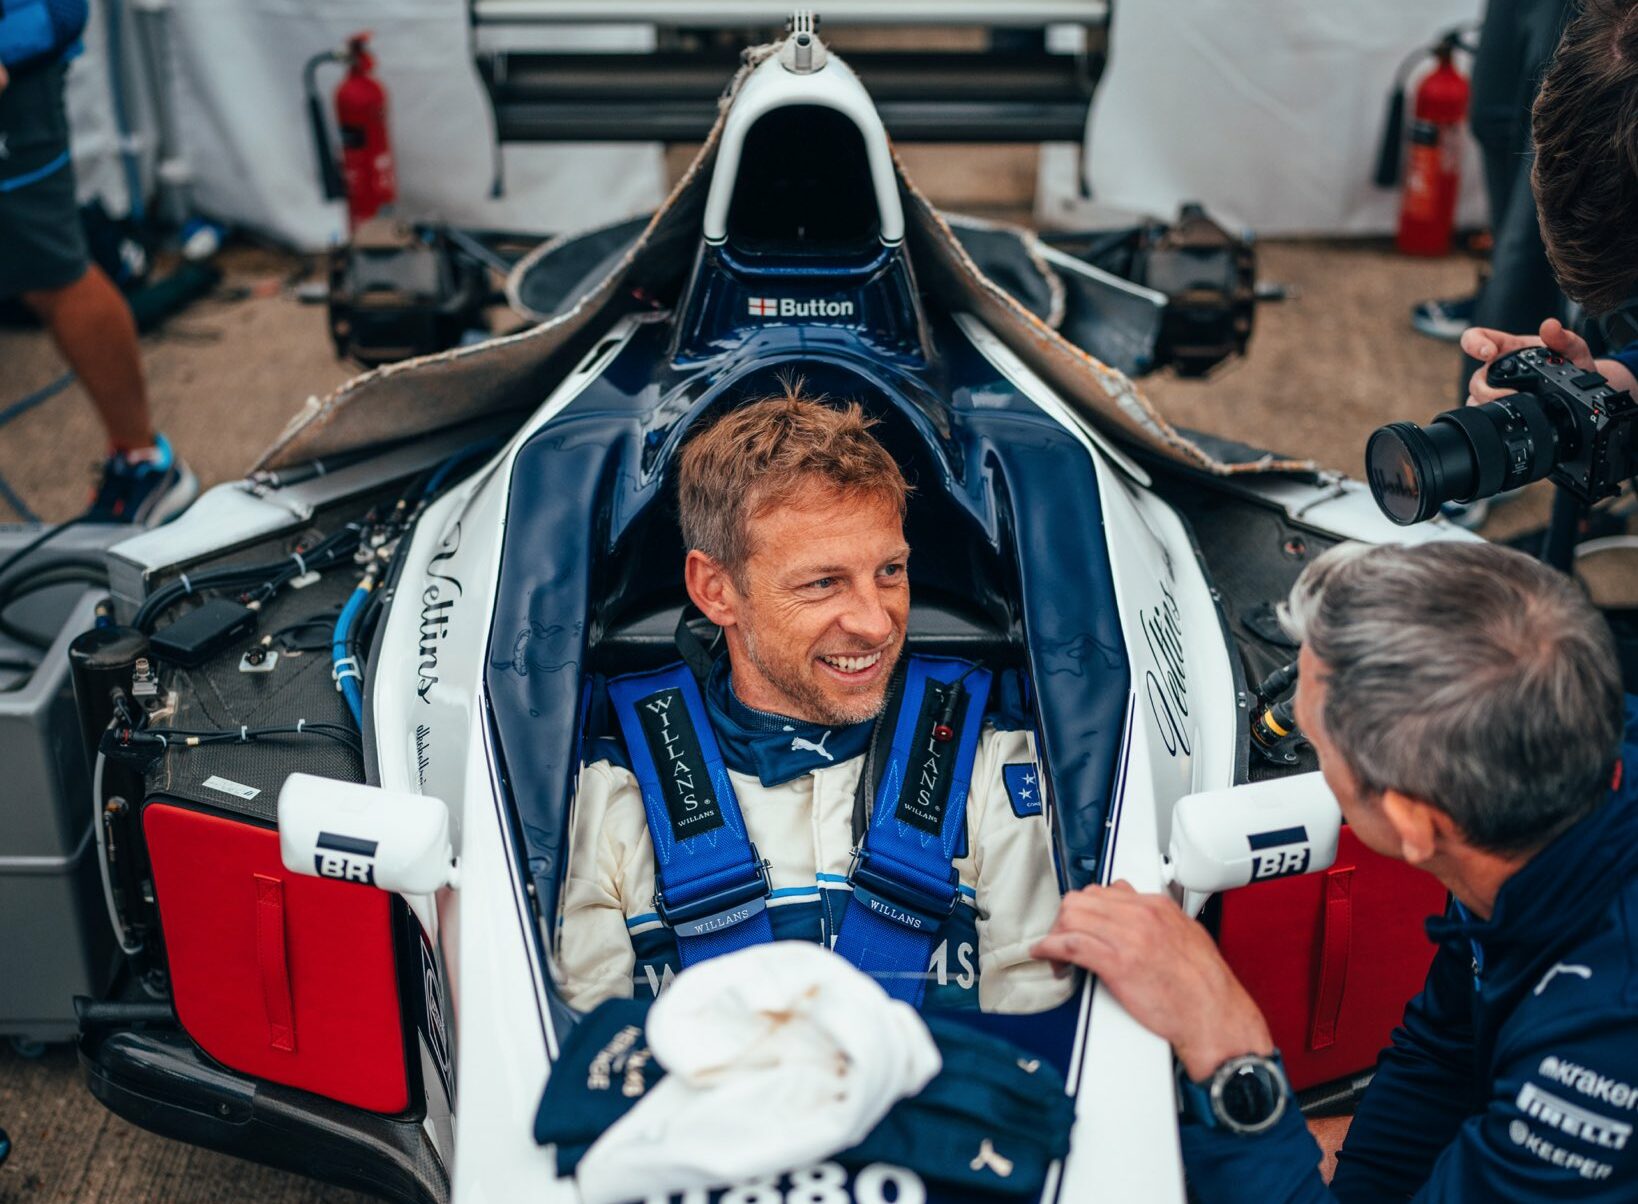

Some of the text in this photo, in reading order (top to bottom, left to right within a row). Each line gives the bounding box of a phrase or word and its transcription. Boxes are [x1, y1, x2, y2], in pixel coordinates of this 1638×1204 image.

[780, 298, 854, 317] Button
[646, 696, 699, 812] WILLANS
[677, 810, 715, 828] WILLANS
[904, 803, 938, 824] WILLANS
[320, 855, 370, 883] BR
[1256, 847, 1306, 878] BR
[694, 909, 750, 934] WILLANS
[870, 899, 922, 929] WILLANS
[1515, 1081, 1633, 1151] PIRELLI
[1525, 1133, 1613, 1180] KEEPER
